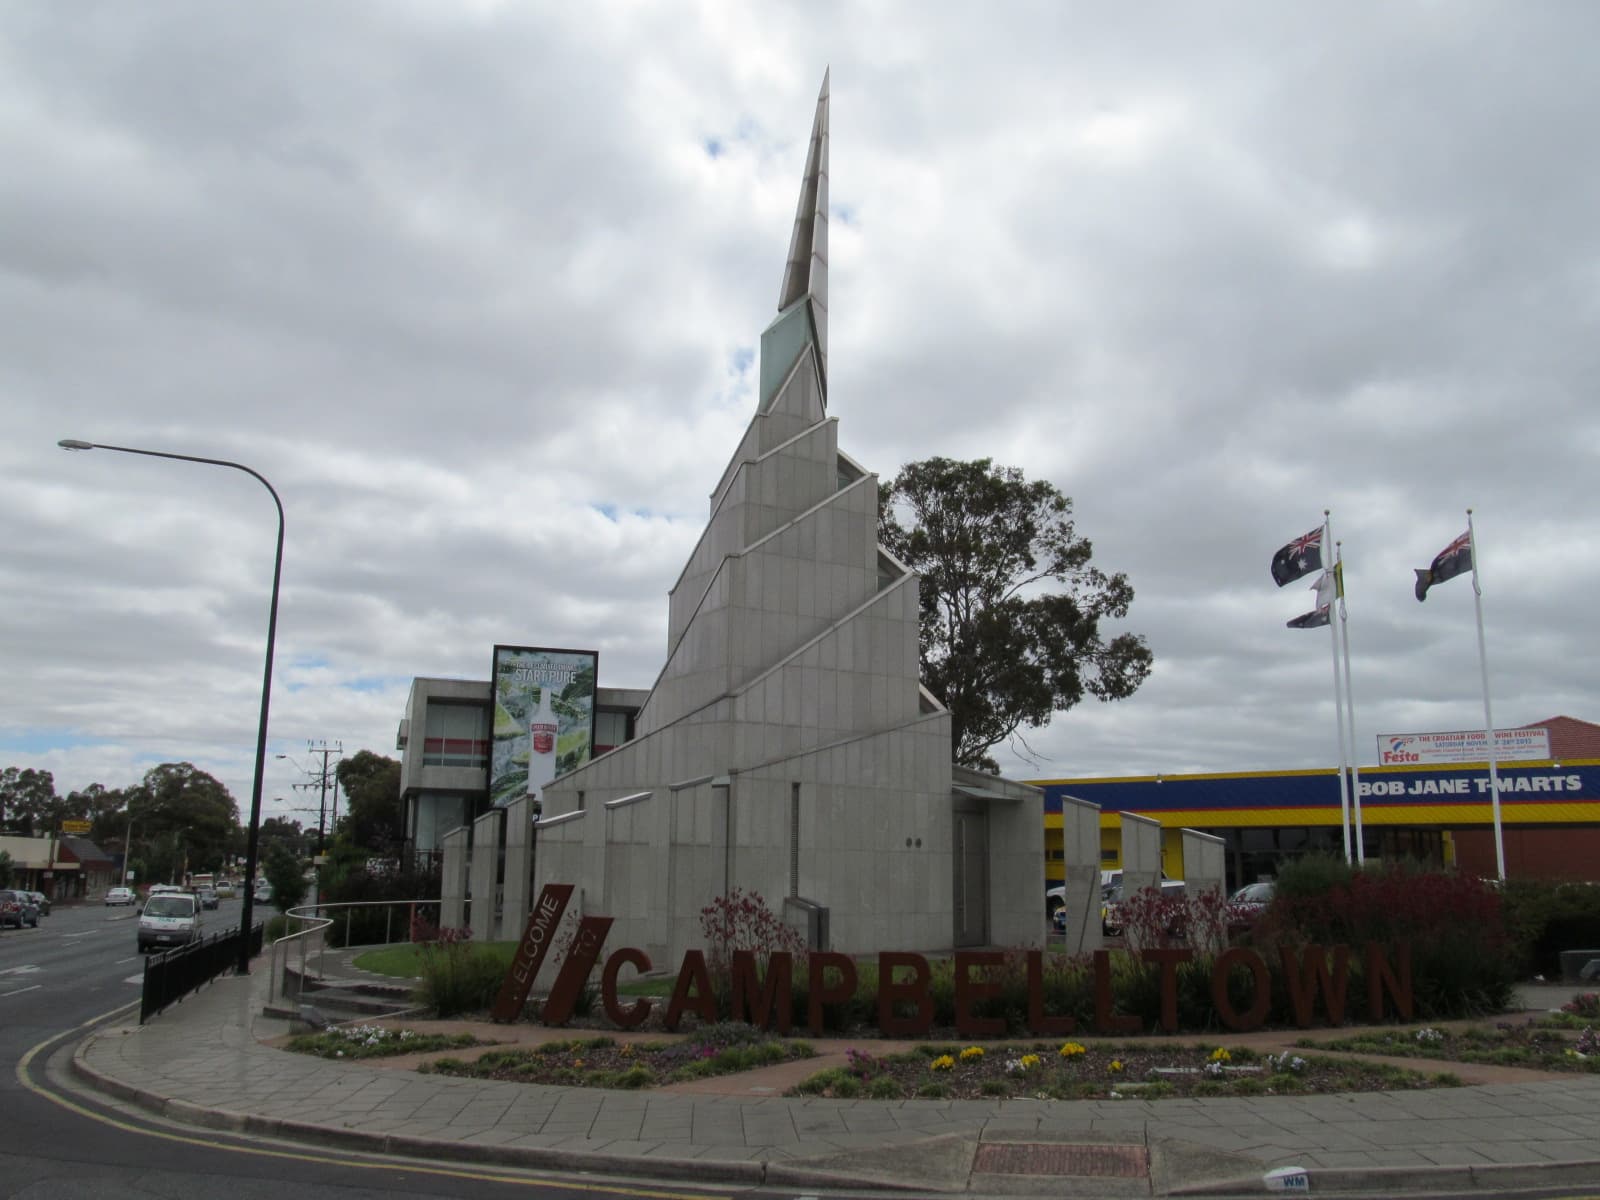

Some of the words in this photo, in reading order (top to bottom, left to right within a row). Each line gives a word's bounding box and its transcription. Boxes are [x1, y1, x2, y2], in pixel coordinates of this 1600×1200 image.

[515, 668, 547, 682] START
[549, 670, 577, 684] PURE
[1514, 730, 1545, 738] FESTIVAL
[1359, 781, 1405, 796] BOB
[1409, 778, 1470, 795] JANE
[601, 941, 1414, 1037] CAMPBELLTOWN
[1284, 1175, 1305, 1187] WM
